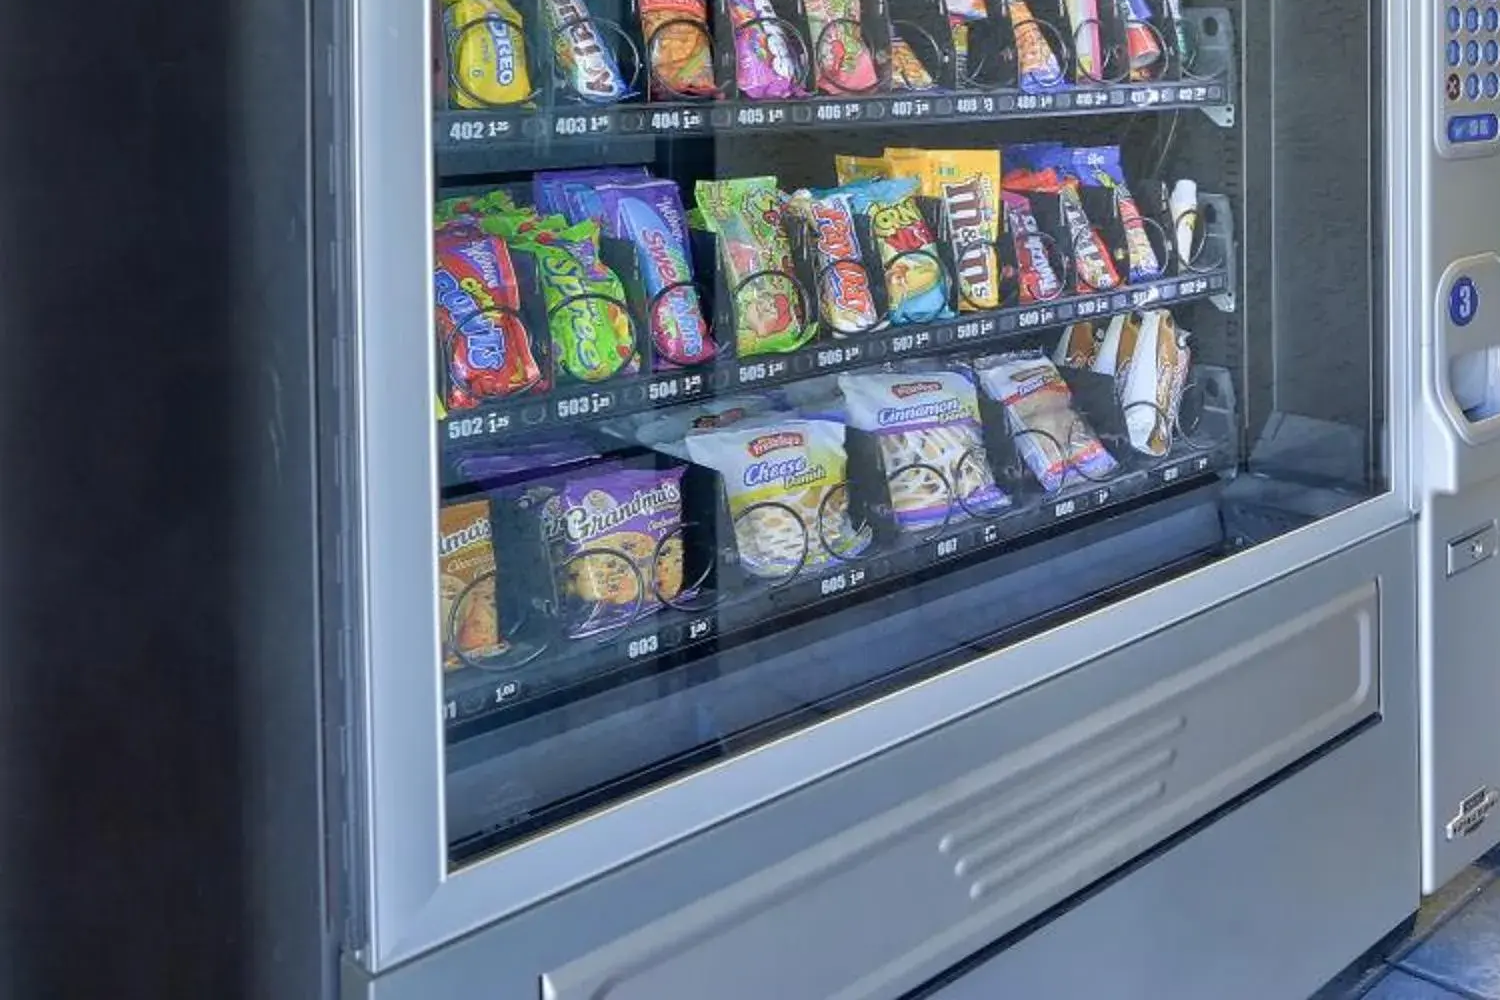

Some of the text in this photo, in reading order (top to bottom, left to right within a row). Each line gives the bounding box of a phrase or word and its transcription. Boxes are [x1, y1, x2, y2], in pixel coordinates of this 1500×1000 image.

[485, 10, 513, 85] OREO
[738, 108, 764, 125] 405
[818, 105, 841, 120] 406
[892, 100, 912, 116] 407
[449, 121, 484, 140] 402
[556, 118, 587, 135] 403
[652, 112, 679, 129] 404
[1459, 285, 1471, 318] 3
[739, 365, 765, 383] 505
[649, 380, 677, 400] 504
[558, 396, 589, 418] 503
[878, 399, 961, 426] Cinnamon
[448, 416, 483, 440] 502
[744, 455, 807, 487] Cheese
[564, 482, 682, 545] Grandma's
[821, 576, 846, 594] 605
[628, 635, 658, 659] 603
